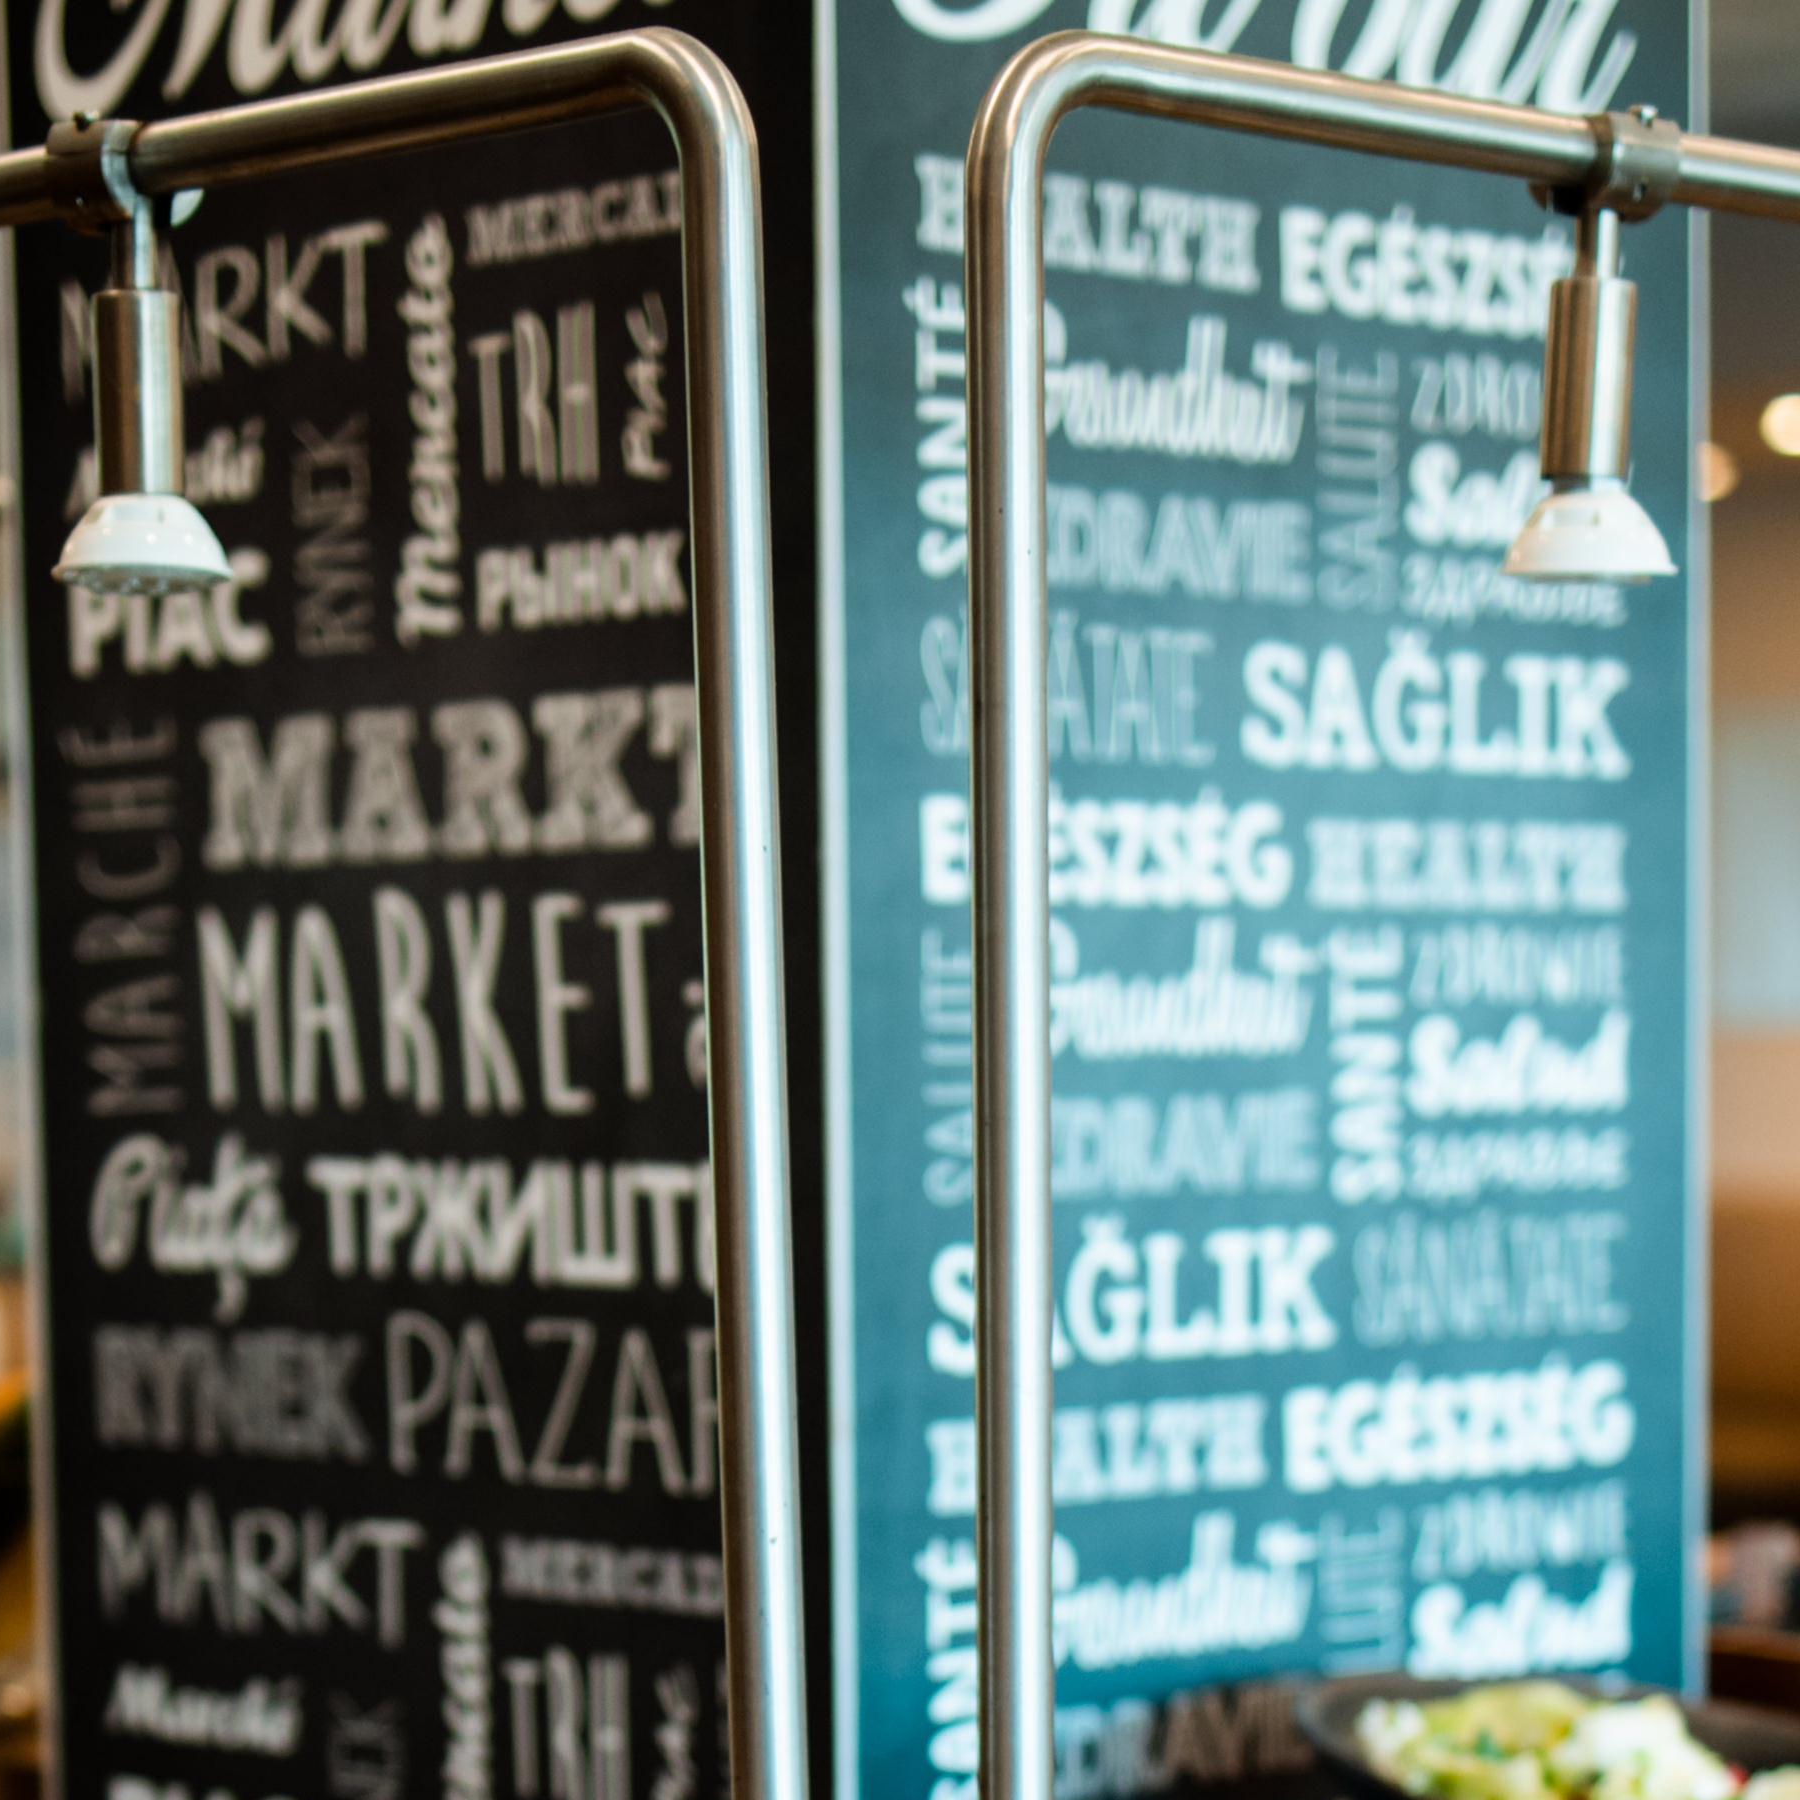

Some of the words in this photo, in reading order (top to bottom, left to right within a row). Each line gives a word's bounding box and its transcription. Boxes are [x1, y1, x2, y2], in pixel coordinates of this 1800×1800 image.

[916, 155, 1261, 294] HALTH
[1279, 203, 1575, 338] EGÉSZSÉ
[467, 298, 600, 487] TRH
[1240, 627, 1632, 779] SAĞLIK
[919, 782, 1293, 908] ESZSÉG
[1307, 818, 1627, 911] HEALTH
[198, 886, 671, 1115] MARKET
[926, 1211, 1337, 1377] SĞLIK
[925, 1391, 1270, 1518] HALTH
[99, 1489, 426, 1651] MARKT
